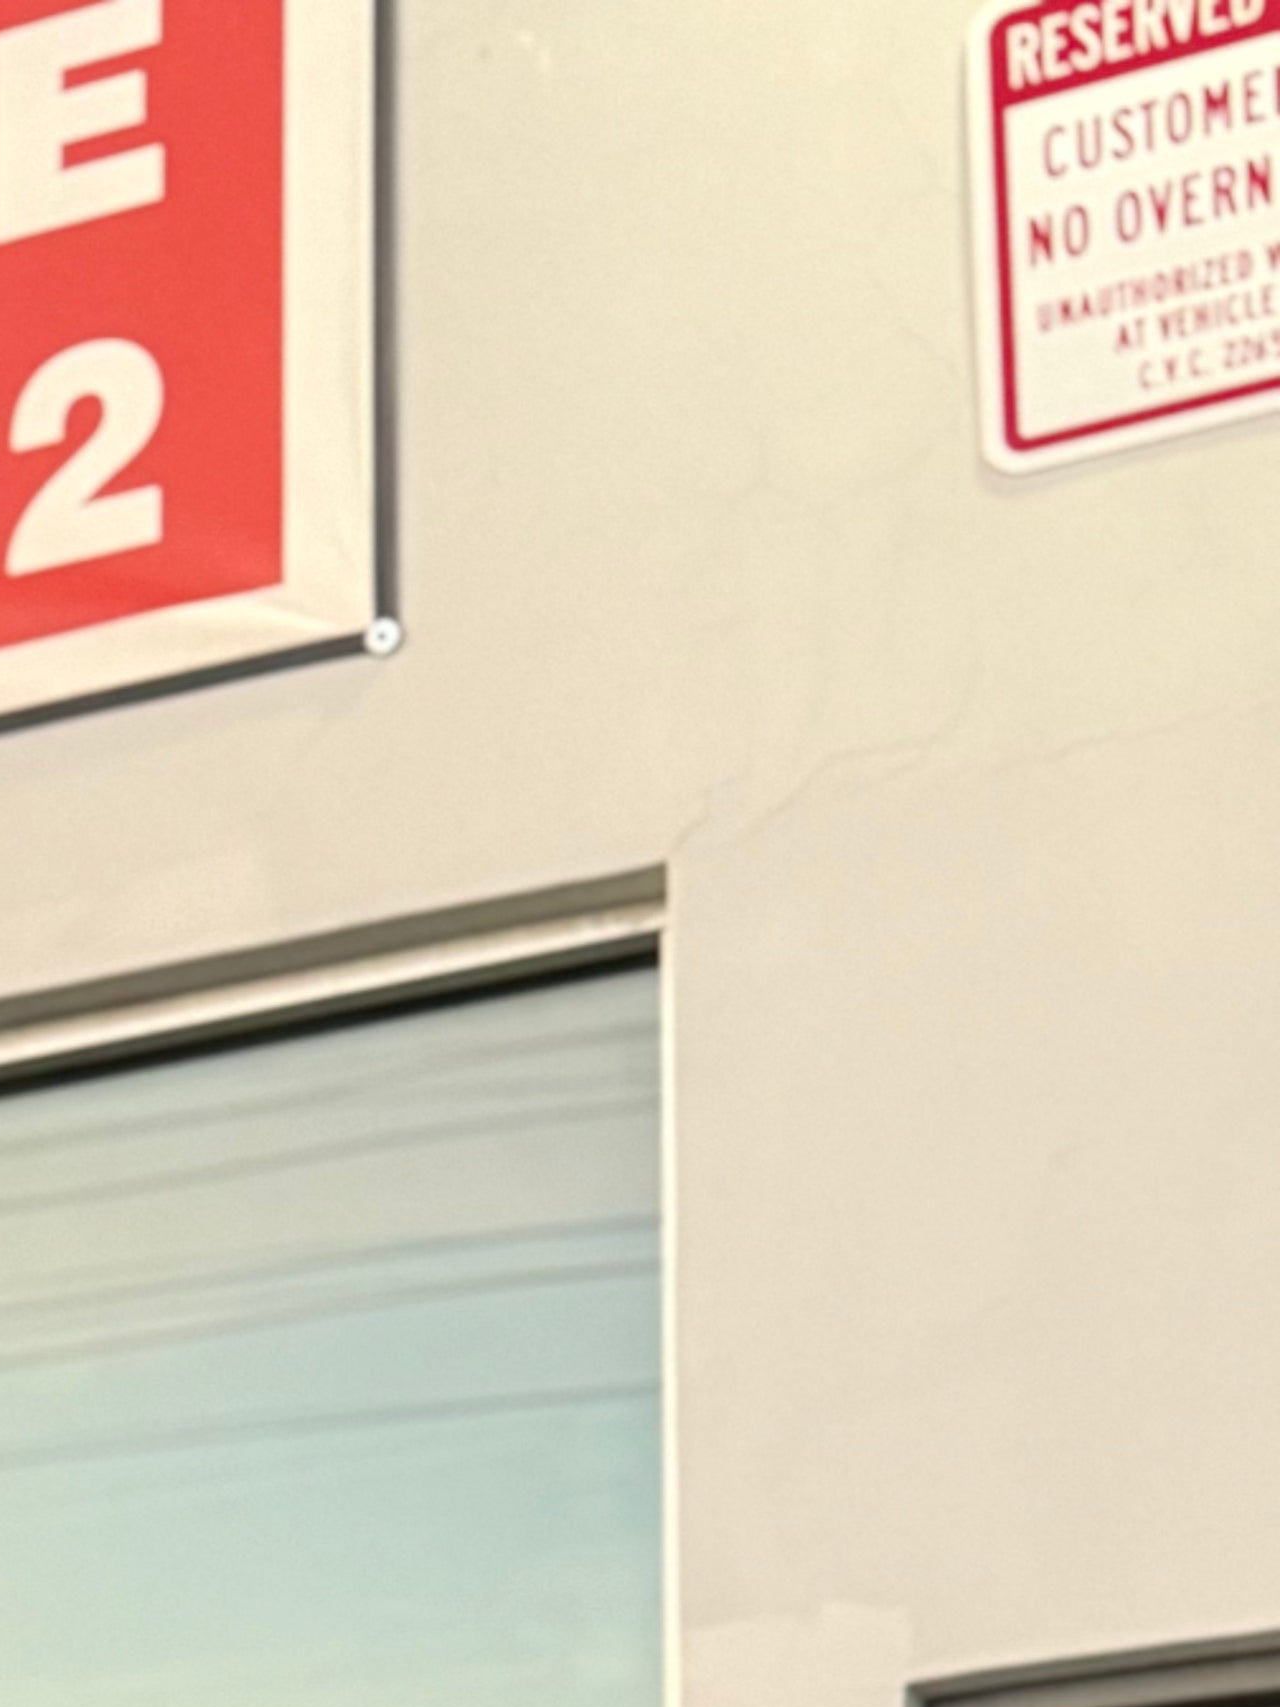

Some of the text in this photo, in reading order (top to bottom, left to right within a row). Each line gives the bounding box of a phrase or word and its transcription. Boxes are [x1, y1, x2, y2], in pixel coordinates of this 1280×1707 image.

[1043, 66, 1280, 177] CUSTOME
[1030, 153, 1272, 266] NO OVERN
[1037, 248, 1252, 332] UNAUTHORIZED
[1115, 283, 1274, 353] AT VEHICLE
